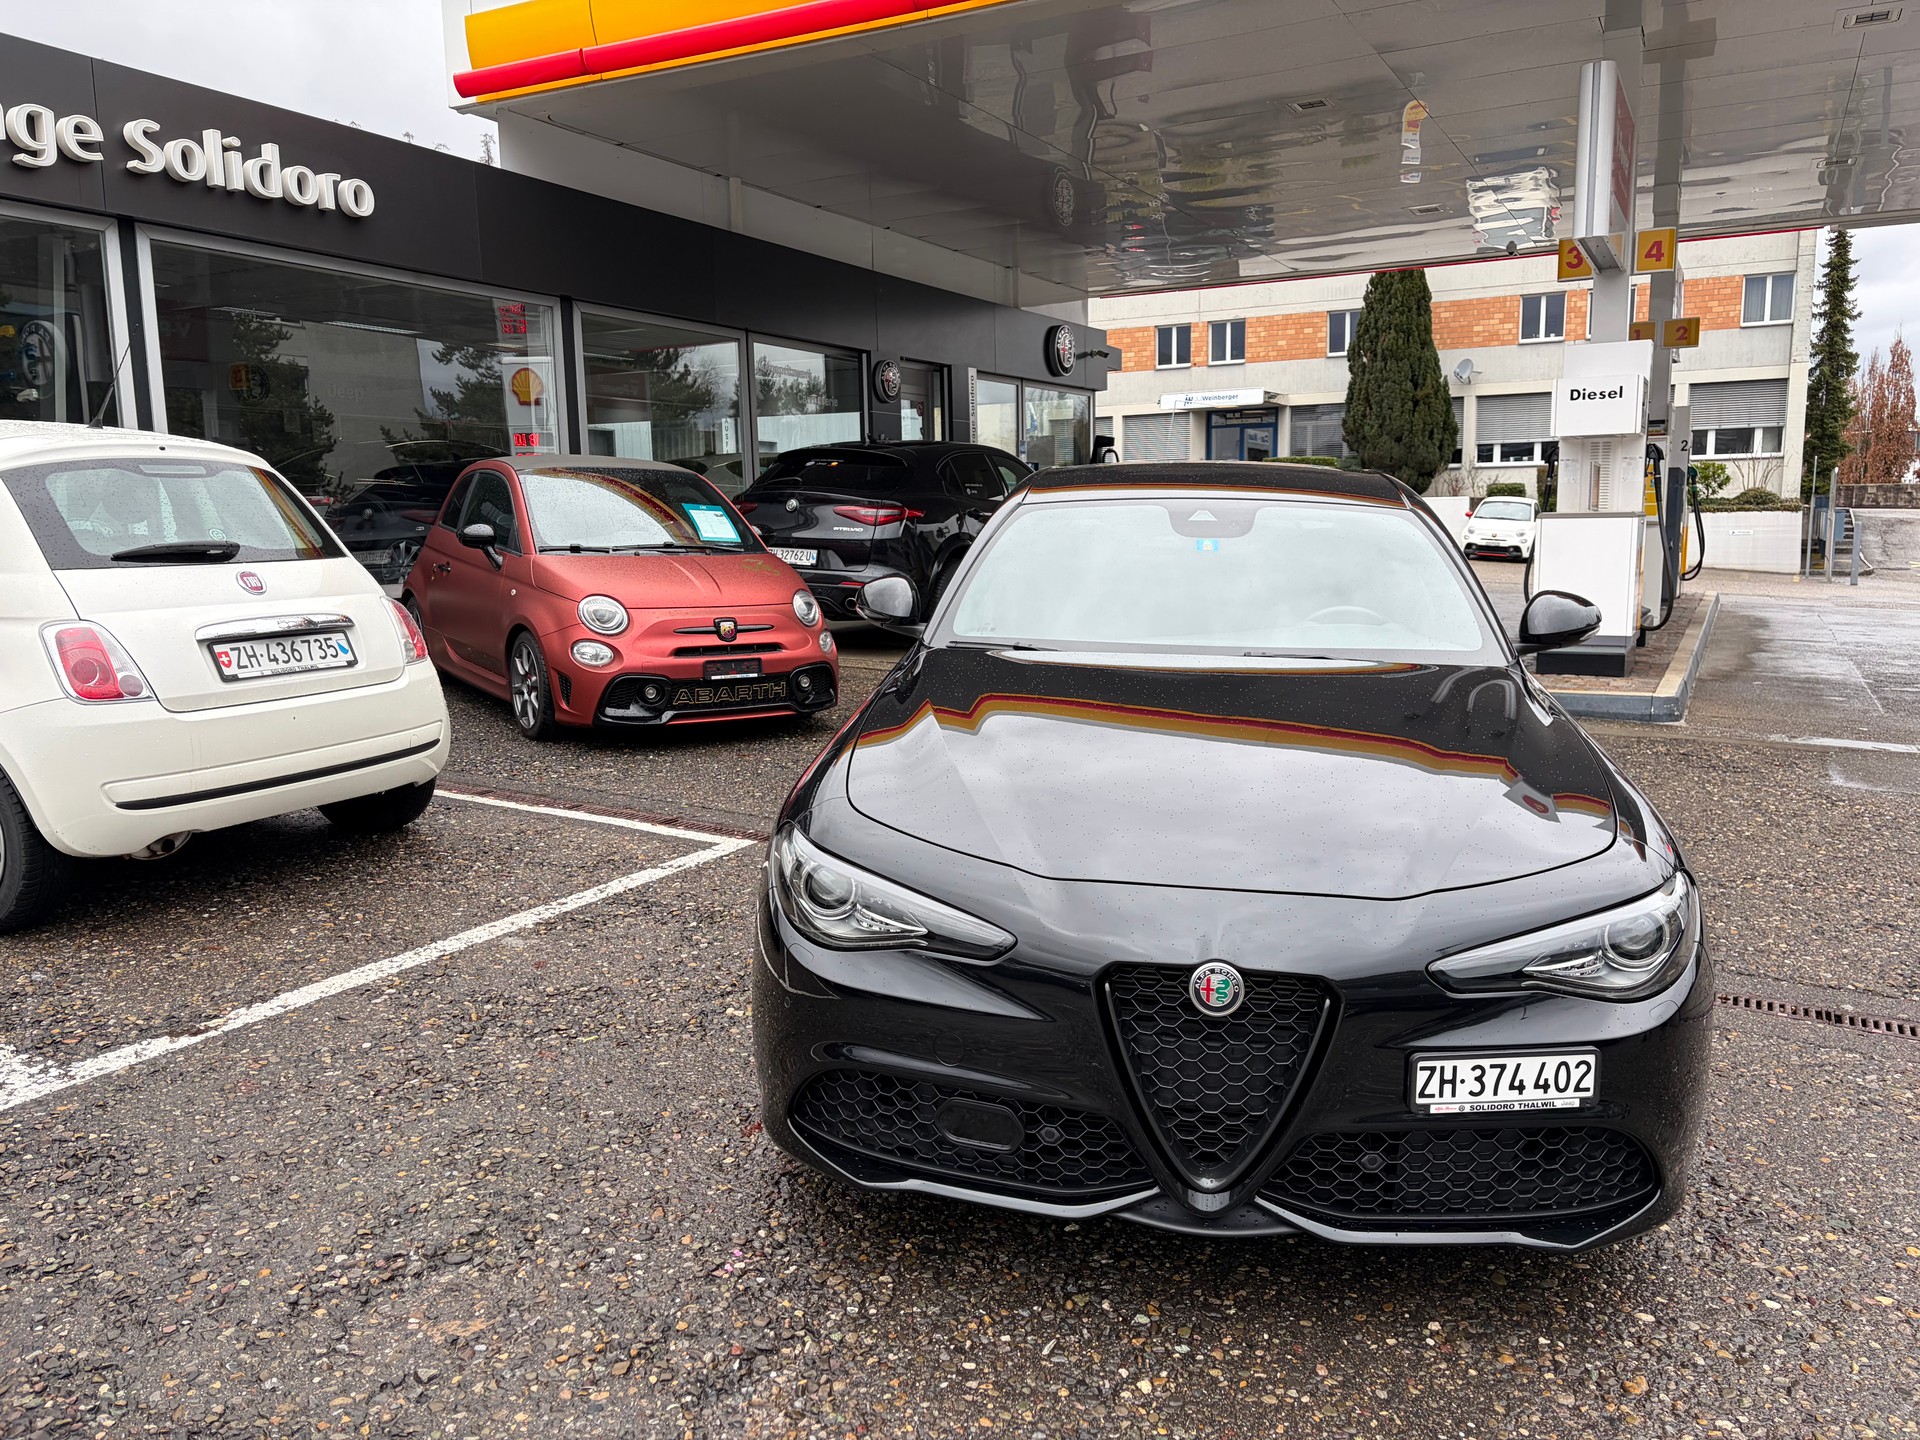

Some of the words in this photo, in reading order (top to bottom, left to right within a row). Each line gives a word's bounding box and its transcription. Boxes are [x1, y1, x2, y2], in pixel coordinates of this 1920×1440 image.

[0, 101, 104, 169] ge
[122, 118, 375, 218] Solidoro
[1565, 247, 1583, 269] 3
[1644, 240, 1665, 262] 4
[1633, 329, 1642, 341] 1
[1675, 326, 1688, 341] 2
[1569, 386, 1623, 401] Diesel
[1680, 440, 1688, 452] 2
[672, 681, 786, 706] ABARTH
[1195, 970, 1212, 989] ALFA
[1214, 968, 1240, 993] ROMEO
[1469, 1103, 1515, 1111] SOLIDORO
[1517, 1101, 1557, 1109] THALWIL
